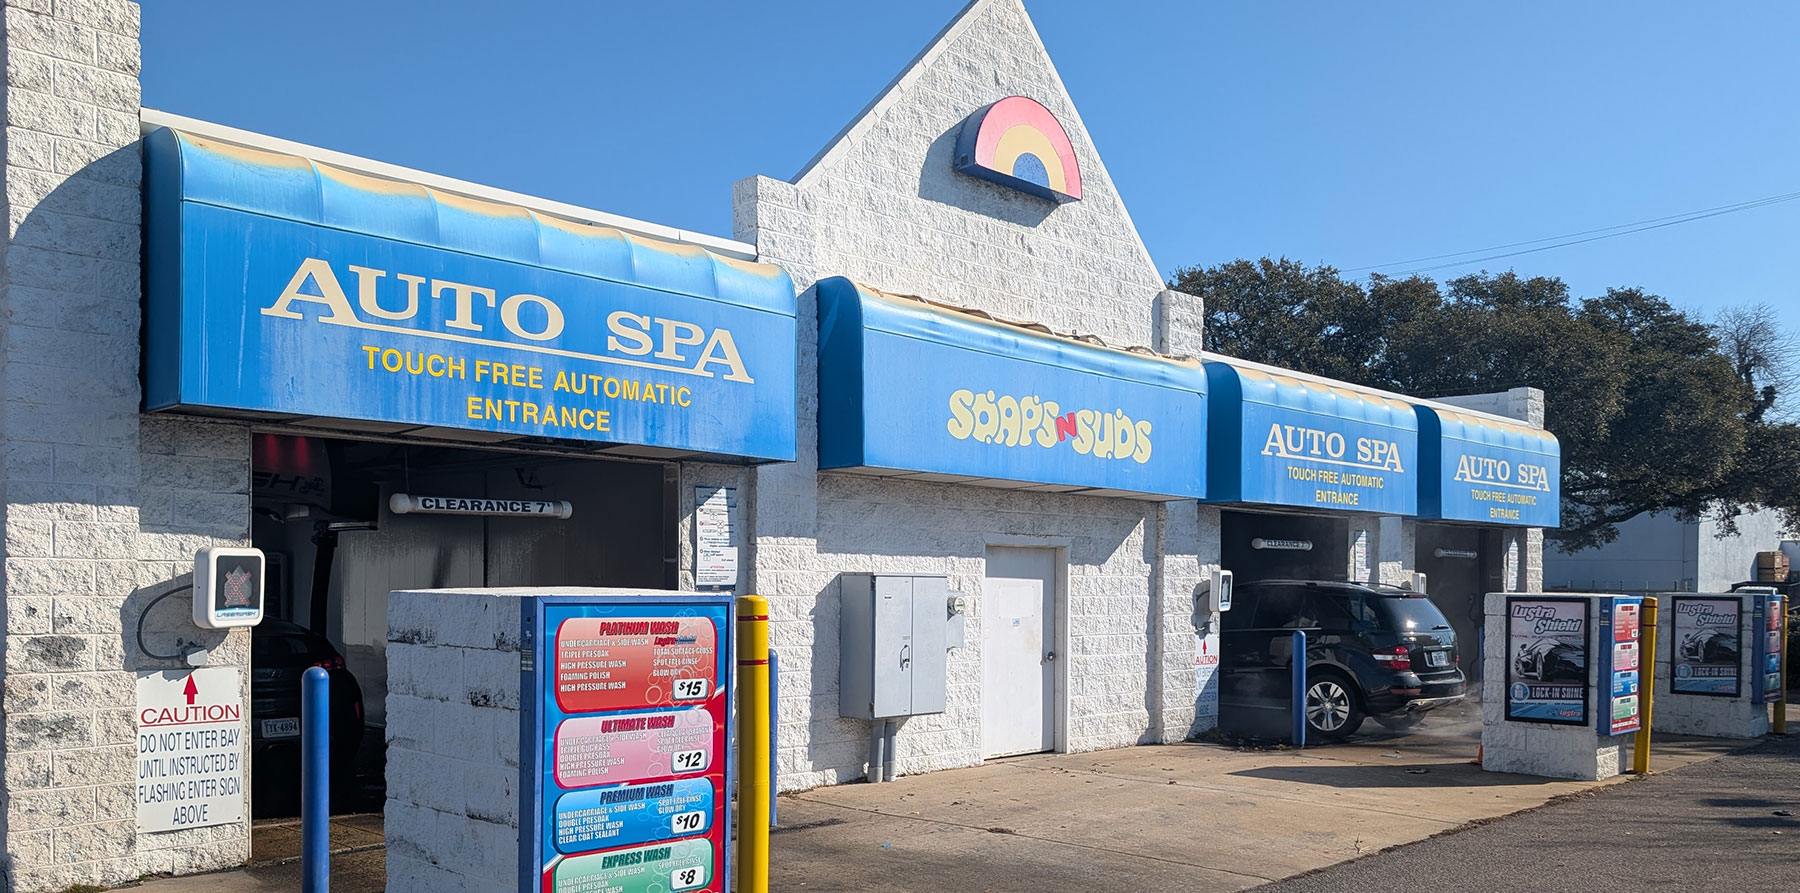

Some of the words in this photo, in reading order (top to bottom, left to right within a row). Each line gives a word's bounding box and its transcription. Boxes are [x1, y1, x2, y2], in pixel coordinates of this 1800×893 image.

[260, 257, 565, 341] AUTO
[606, 310, 754, 384] SPA
[361, 345, 466, 380] TOUCH
[475, 360, 543, 389] FREE
[553, 370, 692, 408] AUTOMATIC
[467, 396, 611, 432] ENTRANCE
[947, 389, 1060, 448] SOAPS
[1056, 412, 1077, 442] N
[1072, 408, 1152, 464] SUDS
[1261, 423, 1346, 458] AUTO
[1357, 437, 1404, 473] SPA
[1287, 466, 1316, 481] TOUCH
[1318, 470, 1339, 484] FREE
[1340, 473, 1384, 489] AUTOMATIC
[1454, 454, 1511, 481] AUTO
[1518, 463, 1550, 492] SPA
[421, 497, 532, 513] CLEARANCE
[1315, 489, 1359, 505] ENTRANCE
[1471, 489, 1491, 501] TOUCH
[1492, 491, 1506, 503] FREE
[1507, 493, 1537, 506] AUTOMATIC
[1490, 507, 1520, 520] ENTRANCE
[1266, 540, 1300, 548] CLEARANCE
[1512, 605, 1557, 622] Lustra
[1677, 603, 1714, 616] Lustra
[1534, 618, 1582, 634] Shield
[1696, 613, 1736, 627] Shield
[600, 621, 649, 636] PLATINUM
[650, 621, 679, 635] WASH
[631, 638, 649, 646] WASH
[561, 650, 581, 659] TRIPLE
[1195, 654, 1218, 664] AUTION
[560, 662, 576, 670] HIGH
[577, 661, 607, 669] PRESSURE
[608, 660, 627, 668] WASH
[560, 672, 588, 681] FOAMING
[589, 671, 610, 680] POLISH
[560, 684, 576, 692] HIGH
[576, 683, 607, 691] PRESSURE
[608, 681, 626, 690] WASH
[678, 681, 702, 696] $15
[1532, 687, 1560, 698] LOCK-IN
[1561, 687, 1584, 699] SHINE
[140, 704, 240, 724] CAUTION
[601, 717, 647, 733] ULTIMATE
[647, 715, 675, 730] WASH
[140, 734, 157, 754] DO
[159, 732, 182, 752] NOT
[185, 730, 218, 750] ENTER
[220, 728, 240, 748] BAY
[629, 732, 647, 740] WASH
[139, 758, 167, 779] UNTIL
[169, 753, 227, 777] INSTRUCTED
[229, 752, 240, 771] BY
[560, 762, 575, 770] HIGH
[576, 759, 606, 769] PRESSURE
[607, 758, 625, 766] WASH
[677, 752, 702, 768] $12
[560, 769, 587, 779] FOAMING
[588, 767, 609, 776] POLISH
[138, 781, 186, 804] FLASHING
[188, 778, 217, 800] ENTER
[219, 776, 240, 797] SIGN
[600, 787, 645, 805] PREMIUM
[646, 784, 674, 799] WASH
[172, 803, 208, 825] ABOVE
[559, 807, 607, 819] UNDERCARRIAGE
[614, 805, 627, 813] SIDE
[628, 802, 646, 811] WASH
[559, 818, 582, 828] DOUBLE
[582, 815, 610, 825] PRESOAK
[559, 827, 574, 836] HIGH
[575, 824, 605, 834] PRESSURE
[605, 820, 624, 829] WASH
[676, 813, 700, 830] $10
[559, 835, 577, 844] CLEAR
[578, 832, 594, 842] COAT
[594, 829, 620, 839] SEALANT
[602, 851, 643, 870] EXPRESS
[643, 846, 672, 862] WASH
[558, 872, 607, 887] UNDERCARRIAGE
[614, 869, 626, 878] SIDE
[627, 866, 645, 876] WASH
[679, 869, 696, 885] $8
[582, 880, 609, 891] PRESOAK
